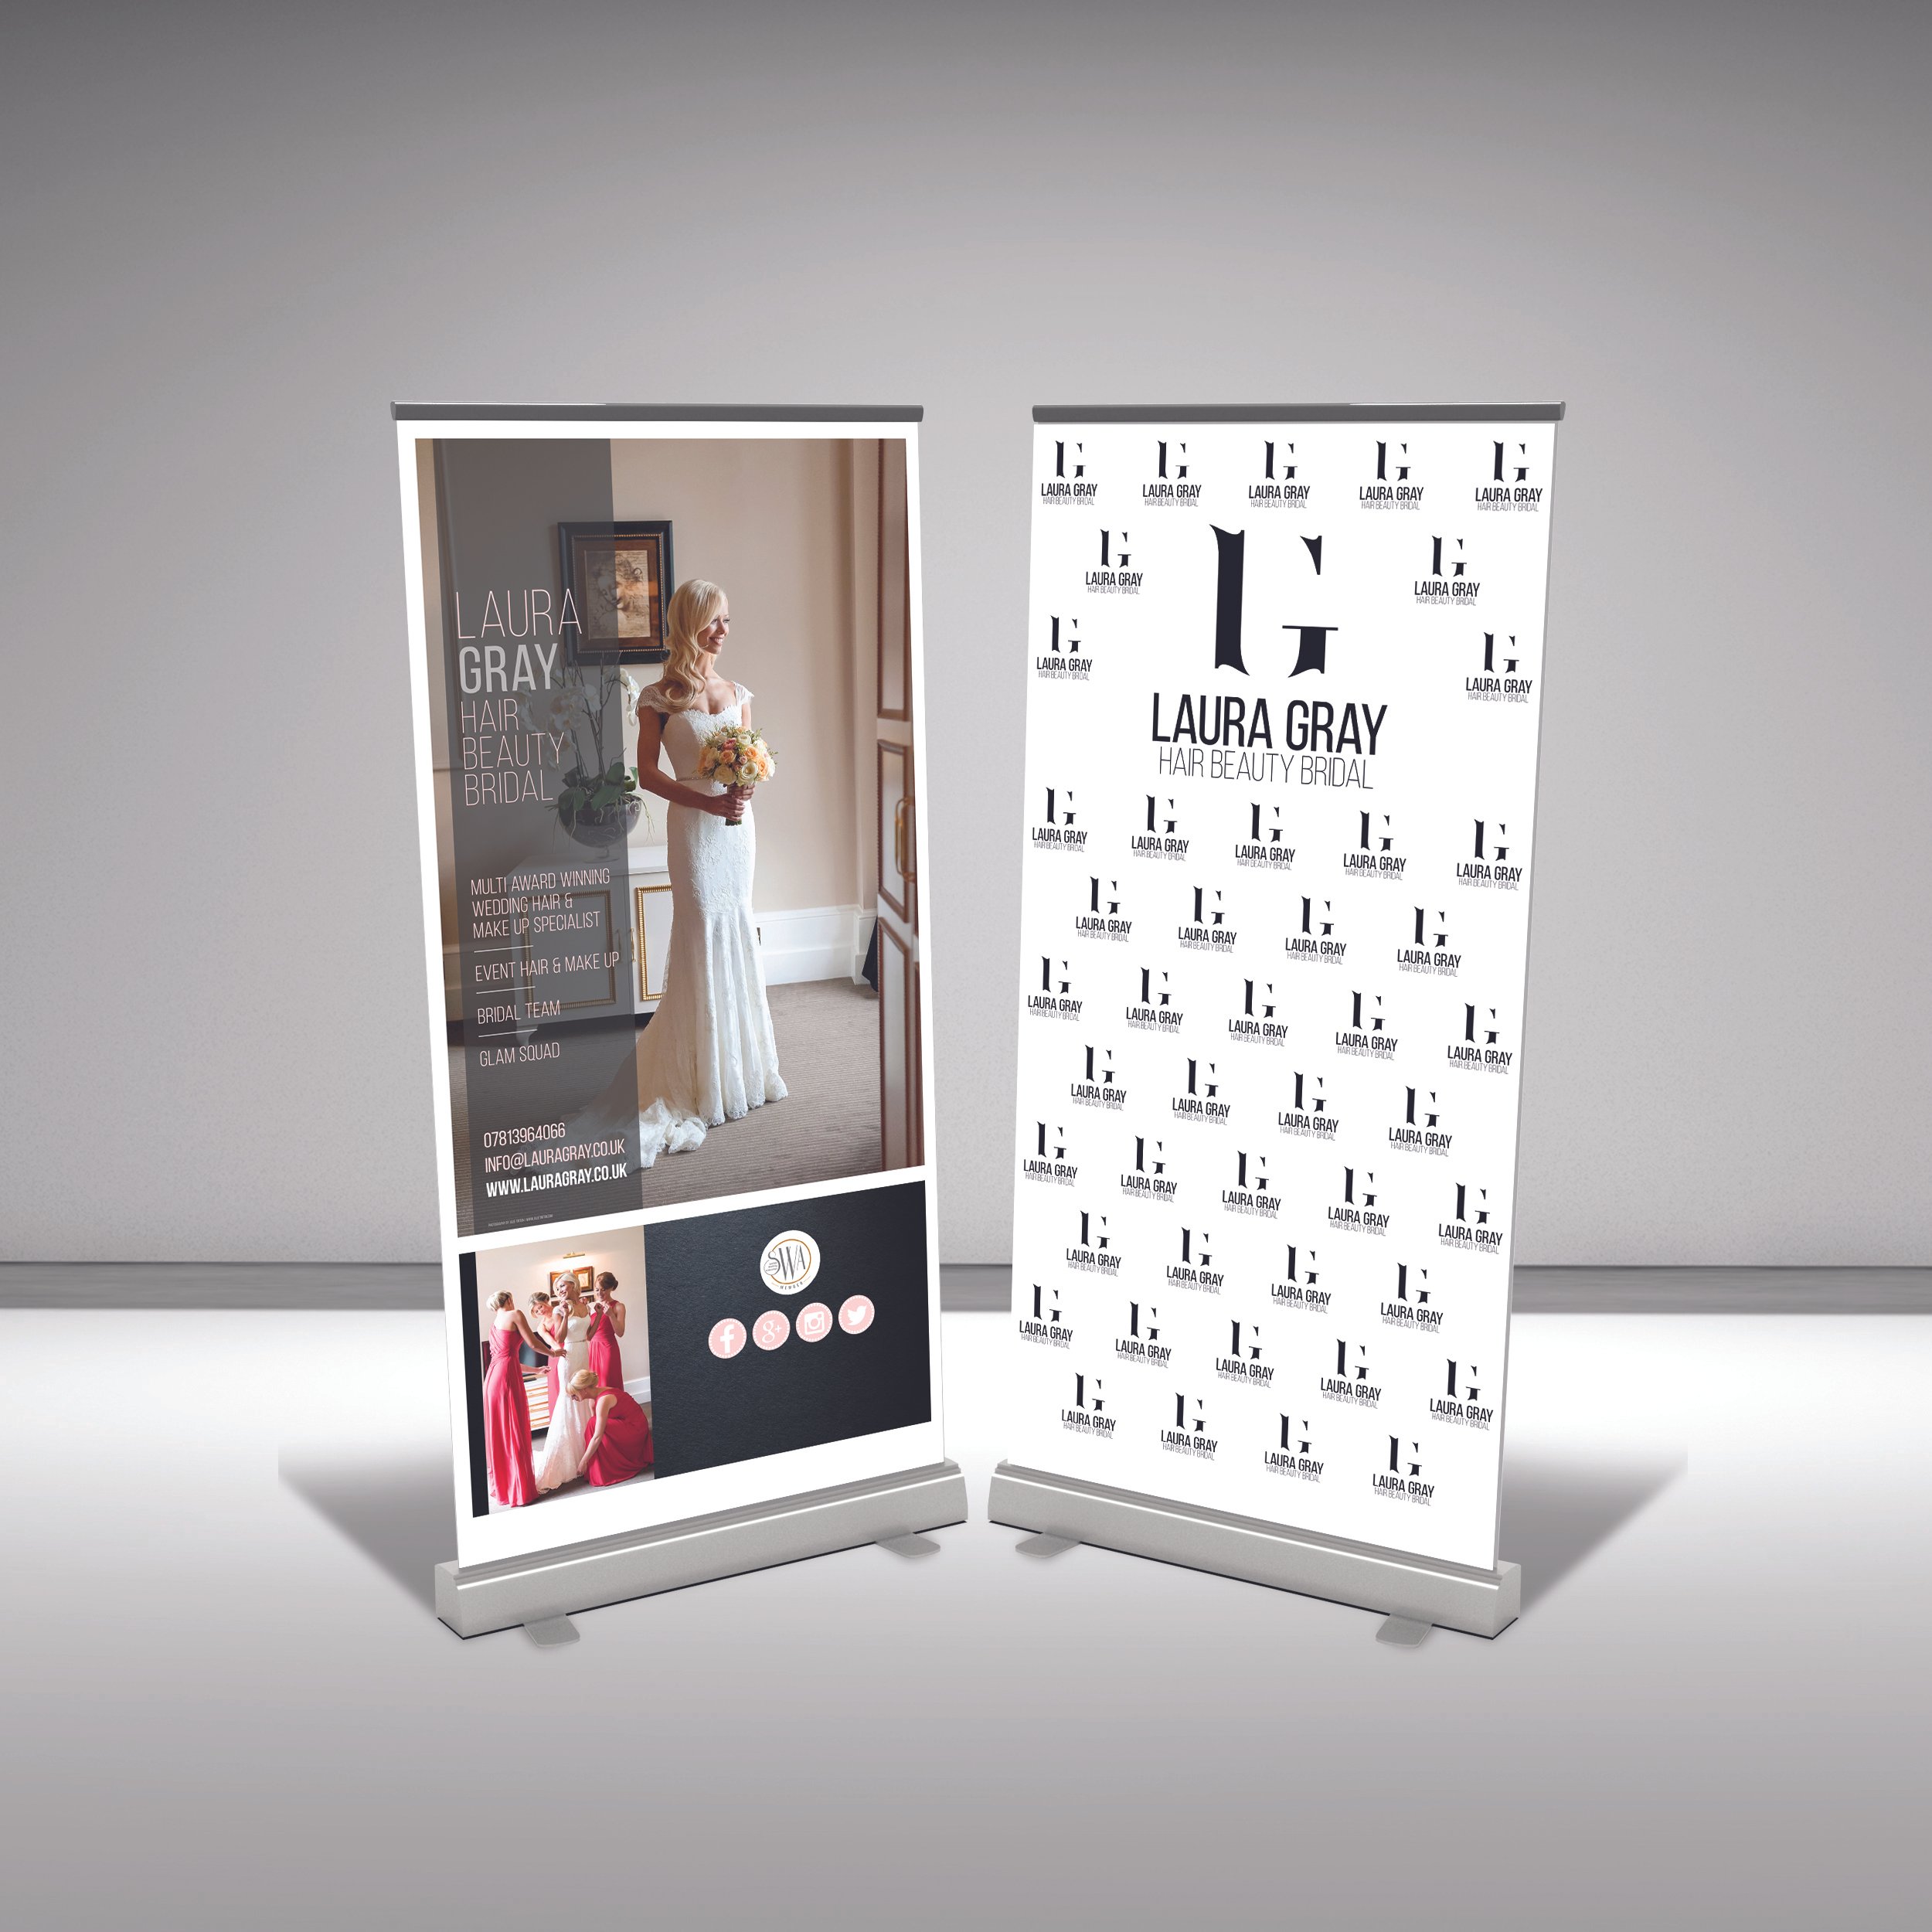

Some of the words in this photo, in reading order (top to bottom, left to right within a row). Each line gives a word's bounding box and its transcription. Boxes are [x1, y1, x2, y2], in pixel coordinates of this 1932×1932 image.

[1041, 483, 1071, 497] LAURA
[1073, 483, 1098, 497] GRAY
[1142, 484, 1175, 498] LAURA
[1176, 484, 1202, 498] GRAY
[1248, 485, 1281, 499] LAURA
[1284, 485, 1311, 500] GRAY
[1359, 486, 1394, 501] LAURA
[1396, 486, 1424, 502] GRAY
[1475, 487, 1511, 502] LAURA
[1514, 488, 1543, 502] GRAY
[1085, 571, 1117, 586] LAURA
[1118, 572, 1144, 587] GRAY
[1414, 580, 1449, 597] LAURA
[1451, 581, 1481, 597] GRAY
[456, 588, 582, 639] LAURA
[459, 643, 558, 694] GRAY
[1036, 656, 1066, 672] LAURA
[1068, 658, 1093, 672] GRAY
[1465, 677, 1501, 692] LAURA
[1504, 679, 1533, 694] GRAY
[461, 699, 519, 734] HAIR
[1151, 692, 1273, 749] LAURA
[1286, 699, 1388, 756] GRAY
[462, 732, 564, 770] BEAUTY
[1159, 746, 1204, 777] HAIR
[1210, 749, 1294, 784] BEAUTY
[1301, 755, 1374, 790] BRIDAL
[464, 769, 553, 806] BRIDAL
[1032, 827, 1062, 842] LAURA
[1063, 829, 1088, 845] GRAY
[1131, 835, 1162, 852] LAURA
[1164, 838, 1189, 854] GRAY
[1235, 844, 1267, 860] LAURA
[1269, 847, 1296, 862] GRAY
[1343, 852, 1377, 870] LAURA
[1379, 855, 1406, 872] GRAY
[471, 876, 507, 896] MULTI
[511, 872, 556, 893] AWARD
[560, 867, 611, 888] WINNING
[1456, 862, 1492, 879] LAURA
[1494, 866, 1522, 882] GRAY
[471, 896, 529, 917] WEDDING
[532, 895, 561, 912] HAIR
[564, 893, 573, 909] &
[473, 919, 510, 939] MAKE
[513, 917, 529, 935] UP
[534, 910, 600, 933] SPECIALIST
[1076, 916, 1106, 932] LAURA
[1107, 919, 1132, 934] GRAY
[1178, 927, 1209, 943] LAURA
[1212, 930, 1237, 945] GRAY
[1285, 937, 1318, 954] LAURA
[1320, 940, 1347, 957] GRAY
[475, 961, 516, 982] EVENT
[520, 958, 549, 978] HAIR
[553, 957, 561, 974] &
[565, 953, 600, 972] MAKE
[604, 951, 619, 968] UP
[1396, 948, 1431, 966] LAURA
[1434, 952, 1461, 969] GRAY
[477, 1005, 521, 1025] BRIDAL
[525, 999, 560, 1019] TEAM
[1028, 995, 1057, 1011] LAURA
[1059, 998, 1083, 1014] GRAY
[1126, 1006, 1157, 1023] LAURA
[1158, 1010, 1184, 1026] GRAY
[1228, 1019, 1260, 1036] LAURA
[1263, 1022, 1289, 1039] GRAY
[1335, 1032, 1369, 1049] LAURA
[1371, 1036, 1399, 1052] GRAY
[479, 1047, 515, 1067] GLAM
[519, 1042, 560, 1063] SQUAD
[1447, 1045, 1482, 1063] LAURA
[1485, 1049, 1513, 1066] GRAY
[1070, 1083, 1101, 1100] LAURA
[1102, 1087, 1127, 1104] GRAY
[1172, 1097, 1203, 1114] LAURA
[1206, 1101, 1231, 1118] GRAY
[1278, 1111, 1311, 1129] LAURA
[1312, 1116, 1339, 1133] GRAY
[483, 1122, 566, 1148] 07813964066
[1389, 1127, 1423, 1145] LAURA
[1425, 1131, 1453, 1148] GRAY
[485, 1138, 625, 1174] INFO@LAURAGRAY.CO.UK
[1023, 1158, 1053, 1175] LAURA
[1054, 1164, 1078, 1179] GRAY
[486, 1162, 628, 1198] WWW.LAURAGRAY.CO.UK
[1121, 1174, 1151, 1191] LAURA
[1153, 1179, 1178, 1195] GRAY
[1222, 1189, 1253, 1207] LAURA
[1256, 1195, 1281, 1211] GRAY
[1328, 1206, 1361, 1224] LAURA
[1363, 1212, 1390, 1228] GRAY
[1438, 1223, 1473, 1242] LAURA
[1475, 1229, 1503, 1247] GRAY
[1066, 1247, 1096, 1265] LAURA
[1097, 1253, 1122, 1269] GRAY
[1166, 1265, 1197, 1283] LAURA
[1199, 1270, 1224, 1287] GRAY
[1271, 1283, 1303, 1301] LAURA
[1305, 1289, 1332, 1306] GRAY
[1380, 1302, 1414, 1321] LAURA
[1416, 1308, 1444, 1325] GRAY
[1019, 1320, 1048, 1338] LAURA
[1049, 1325, 1073, 1342] GRAY
[1115, 1338, 1145, 1356] LAURA
[1147, 1344, 1172, 1361] GRAY
[1216, 1357, 1247, 1376] LAURA
[1249, 1363, 1274, 1381] GRAY
[1320, 1377, 1353, 1396] LAURA
[1355, 1383, 1382, 1401] GRAY
[1061, 1409, 1090, 1427] LAURA
[1092, 1415, 1117, 1432] GRAY
[1430, 1398, 1464, 1417] LAURA
[1466, 1405, 1494, 1423] GRAY
[1161, 1429, 1191, 1448] LAURA
[1193, 1436, 1218, 1453] GRAY
[1264, 1451, 1296, 1470] LAURA
[1298, 1458, 1325, 1475] GRAY
[1372, 1473, 1406, 1493] LAURA
[1407, 1481, 1435, 1498] GRAY
